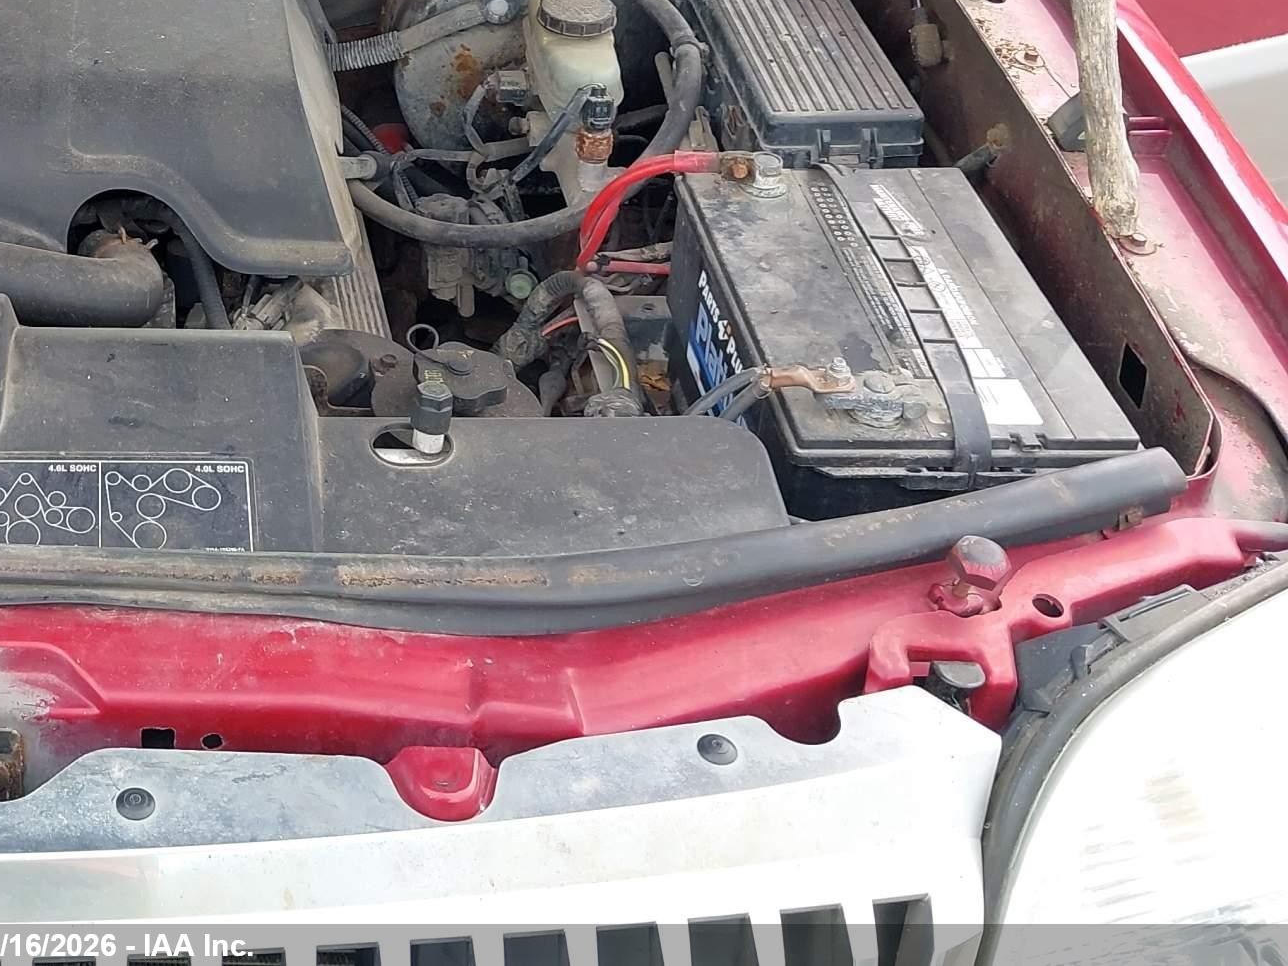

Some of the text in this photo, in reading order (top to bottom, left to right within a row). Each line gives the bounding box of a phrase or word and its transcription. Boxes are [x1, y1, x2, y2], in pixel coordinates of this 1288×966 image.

[698, 270, 743, 374] PARTS PLU
[69, 464, 97, 473] SOHC
[216, 465, 245, 474] SOHC
